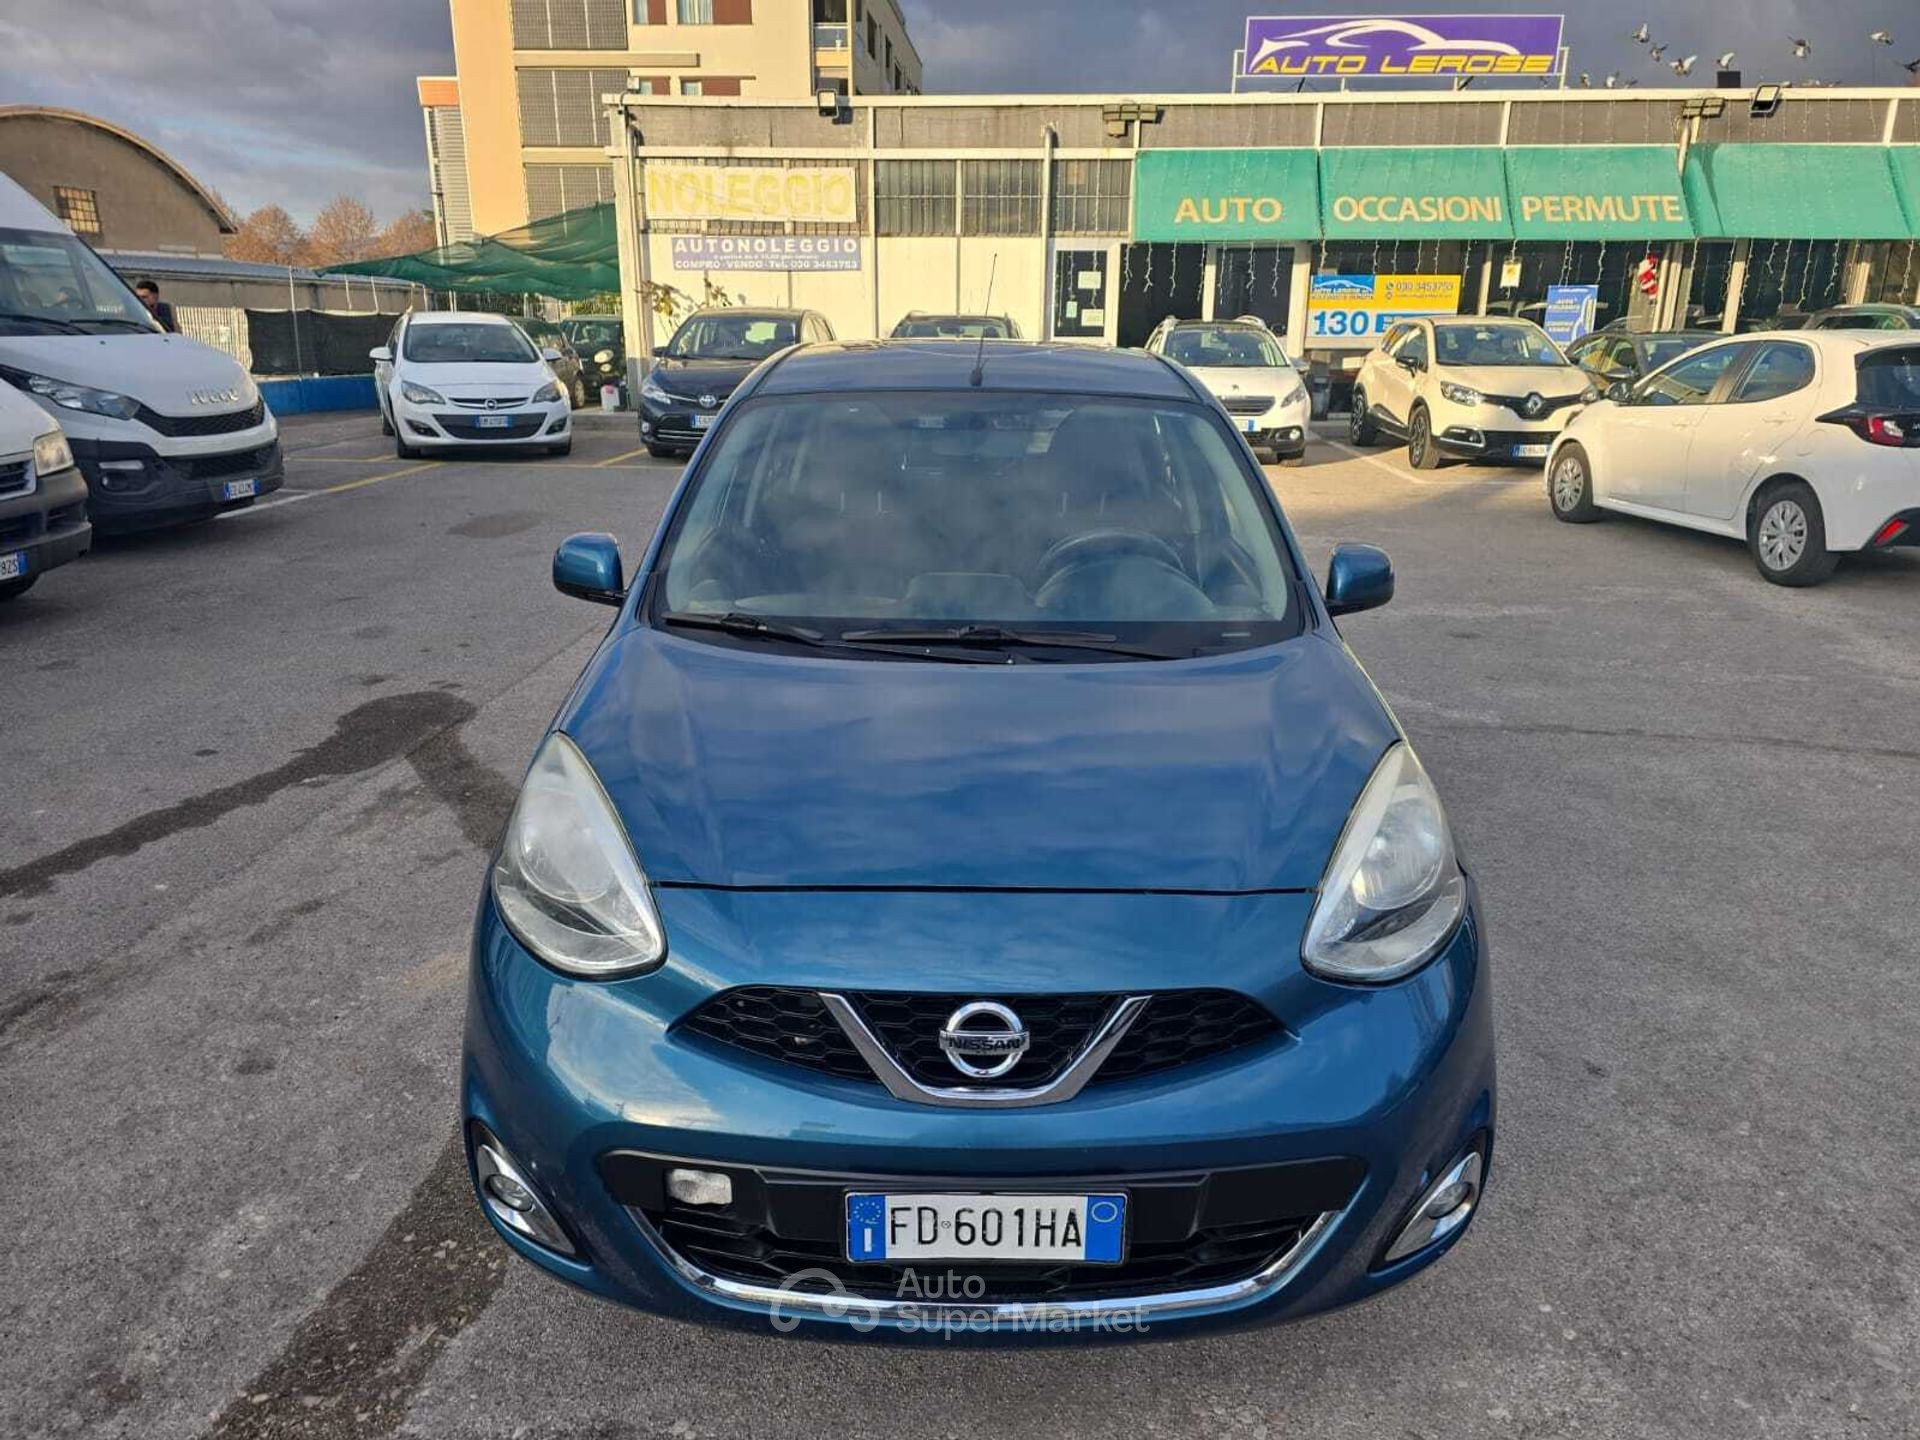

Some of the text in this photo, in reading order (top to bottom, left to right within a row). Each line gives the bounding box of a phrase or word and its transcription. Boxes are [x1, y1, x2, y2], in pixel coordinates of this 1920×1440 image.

[1252, 54, 1554, 74] AUTO LEROSE
[648, 169, 850, 215] NOLEGGIO
[1174, 196, 1283, 223] AUTO
[1332, 195, 1503, 223] OCCASIONI
[1521, 194, 1684, 223] PERMUTE
[674, 239, 858, 254] AUTONOLEGGIO
[675, 260, 720, 269] COMPRO
[727, 260, 763, 269] VENDO
[1314, 311, 1369, 335] 130
[949, 1037, 1021, 1052] NISSAN
